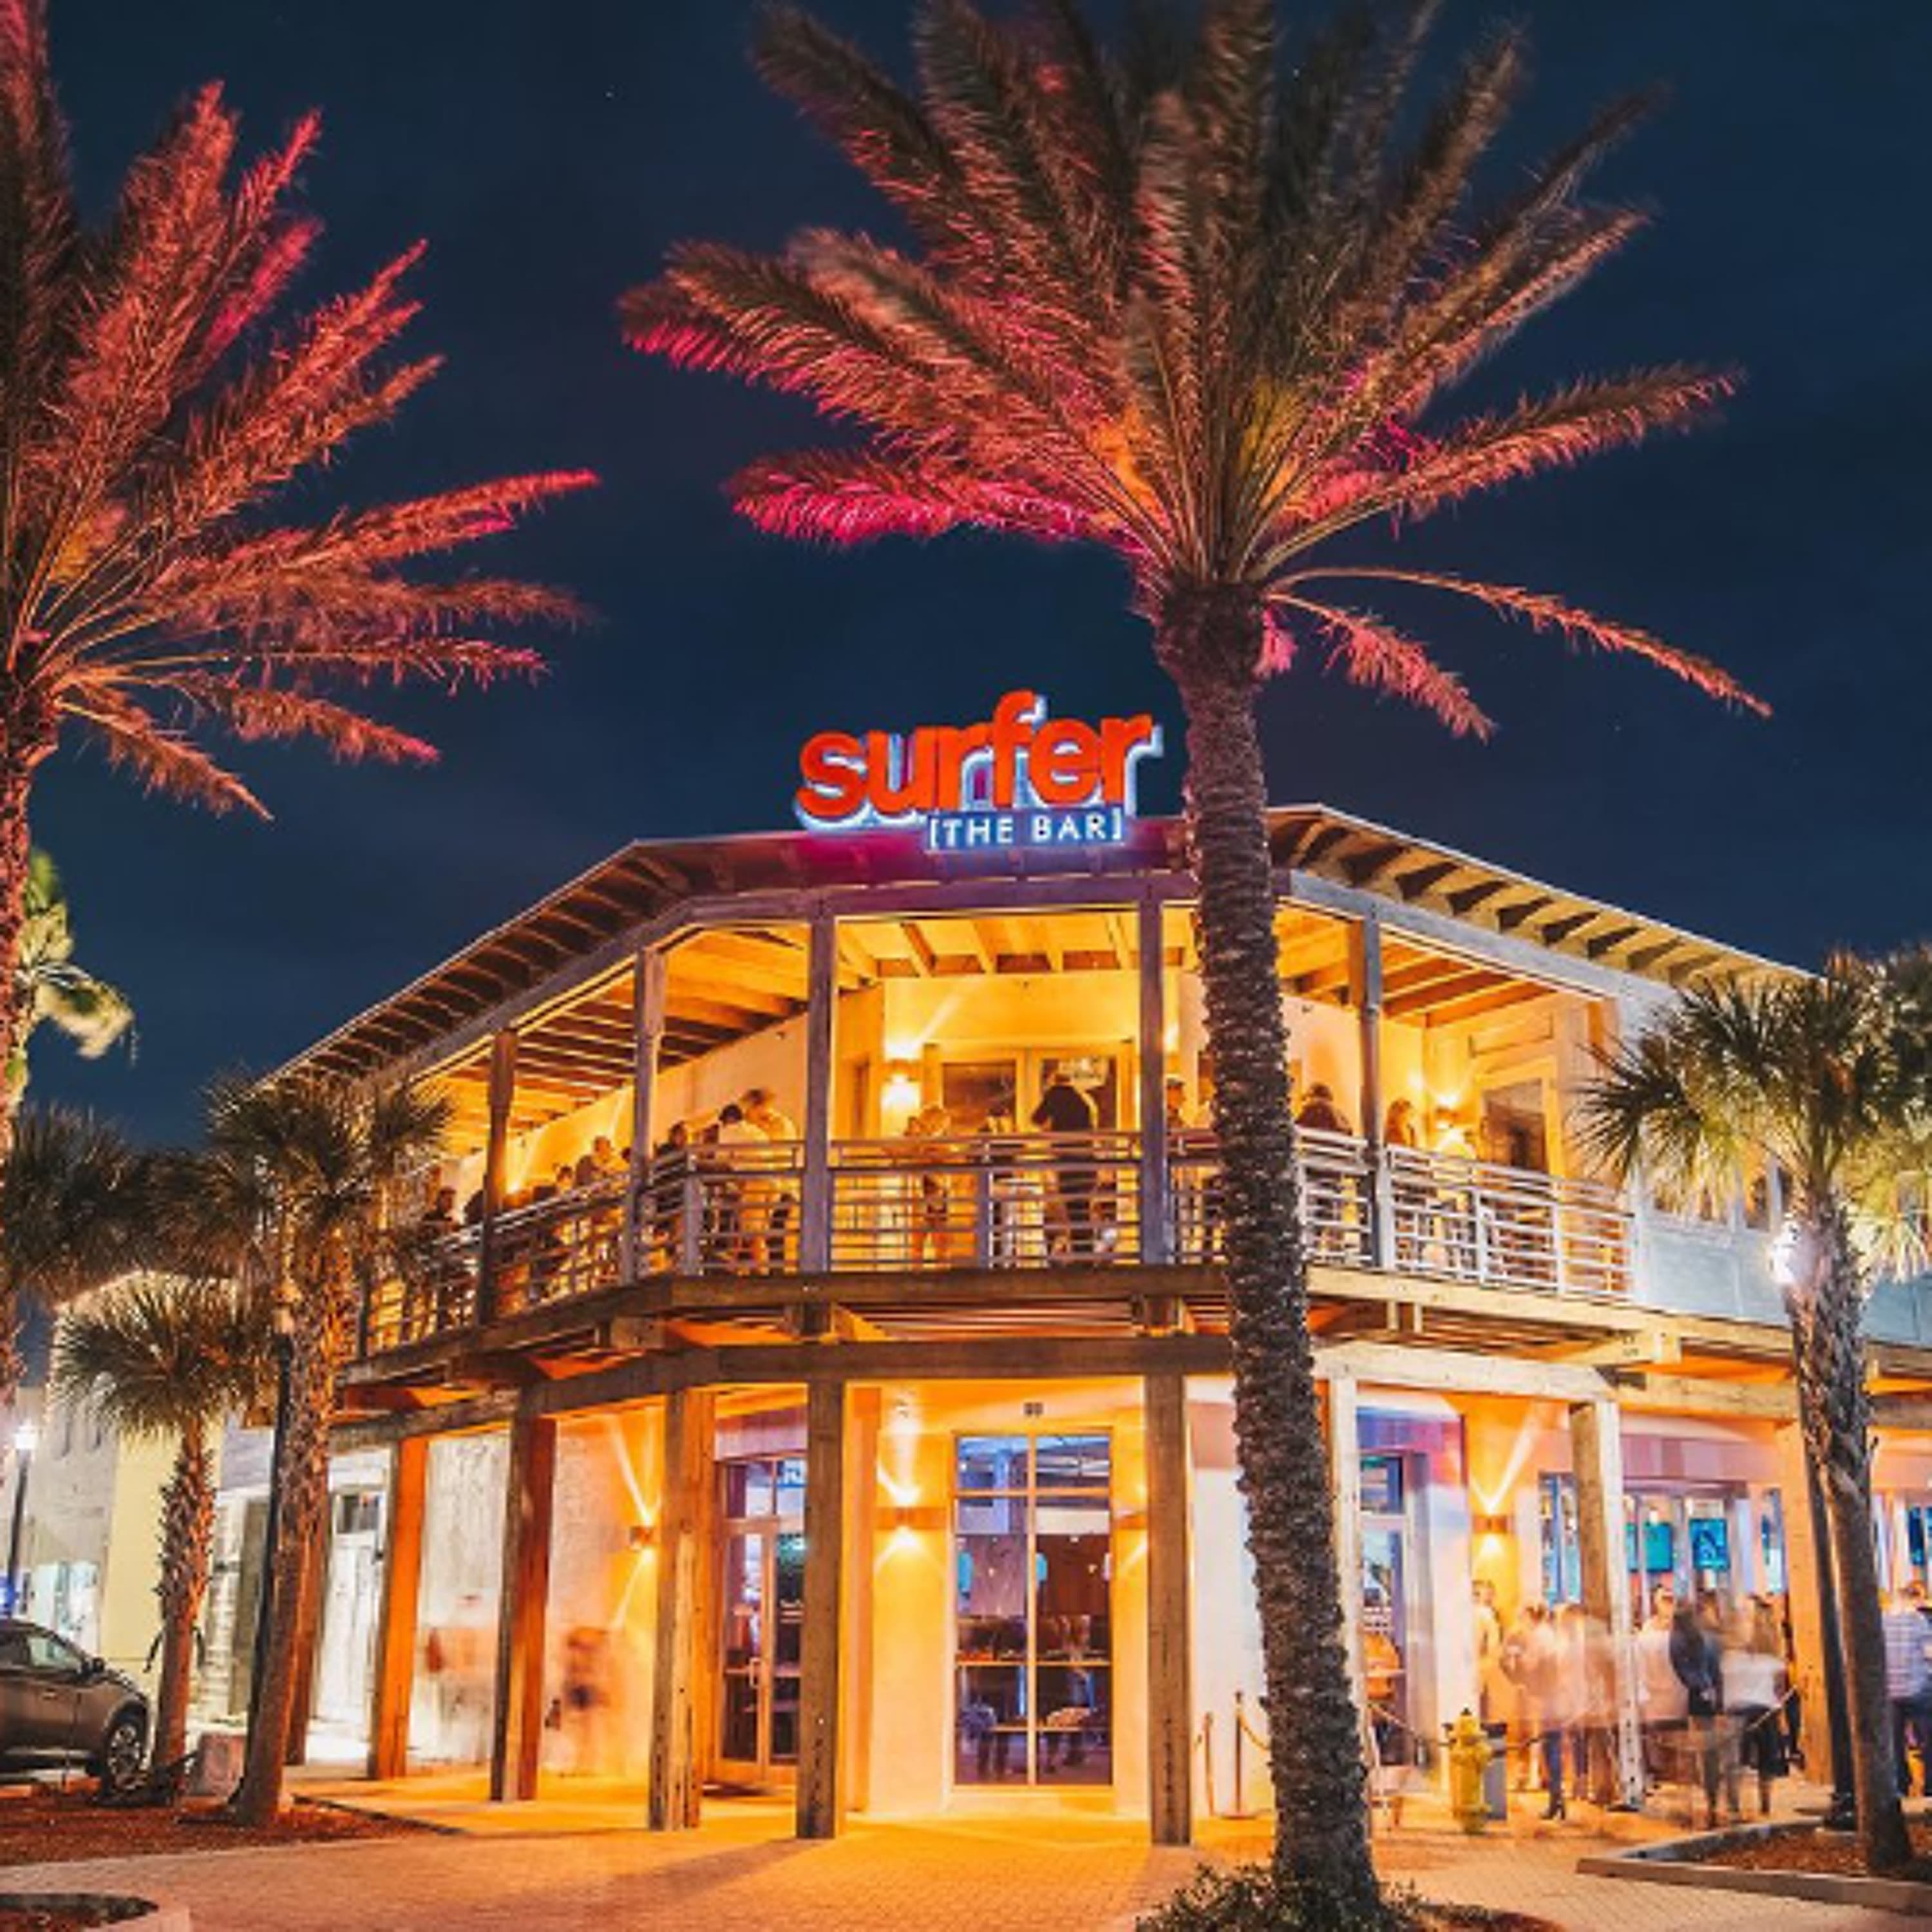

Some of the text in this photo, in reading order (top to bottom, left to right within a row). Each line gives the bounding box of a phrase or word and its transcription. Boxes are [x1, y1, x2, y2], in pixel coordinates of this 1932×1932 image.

[794, 688, 1159, 823] surfer
[929, 806, 1122, 848] [THE BAR]
